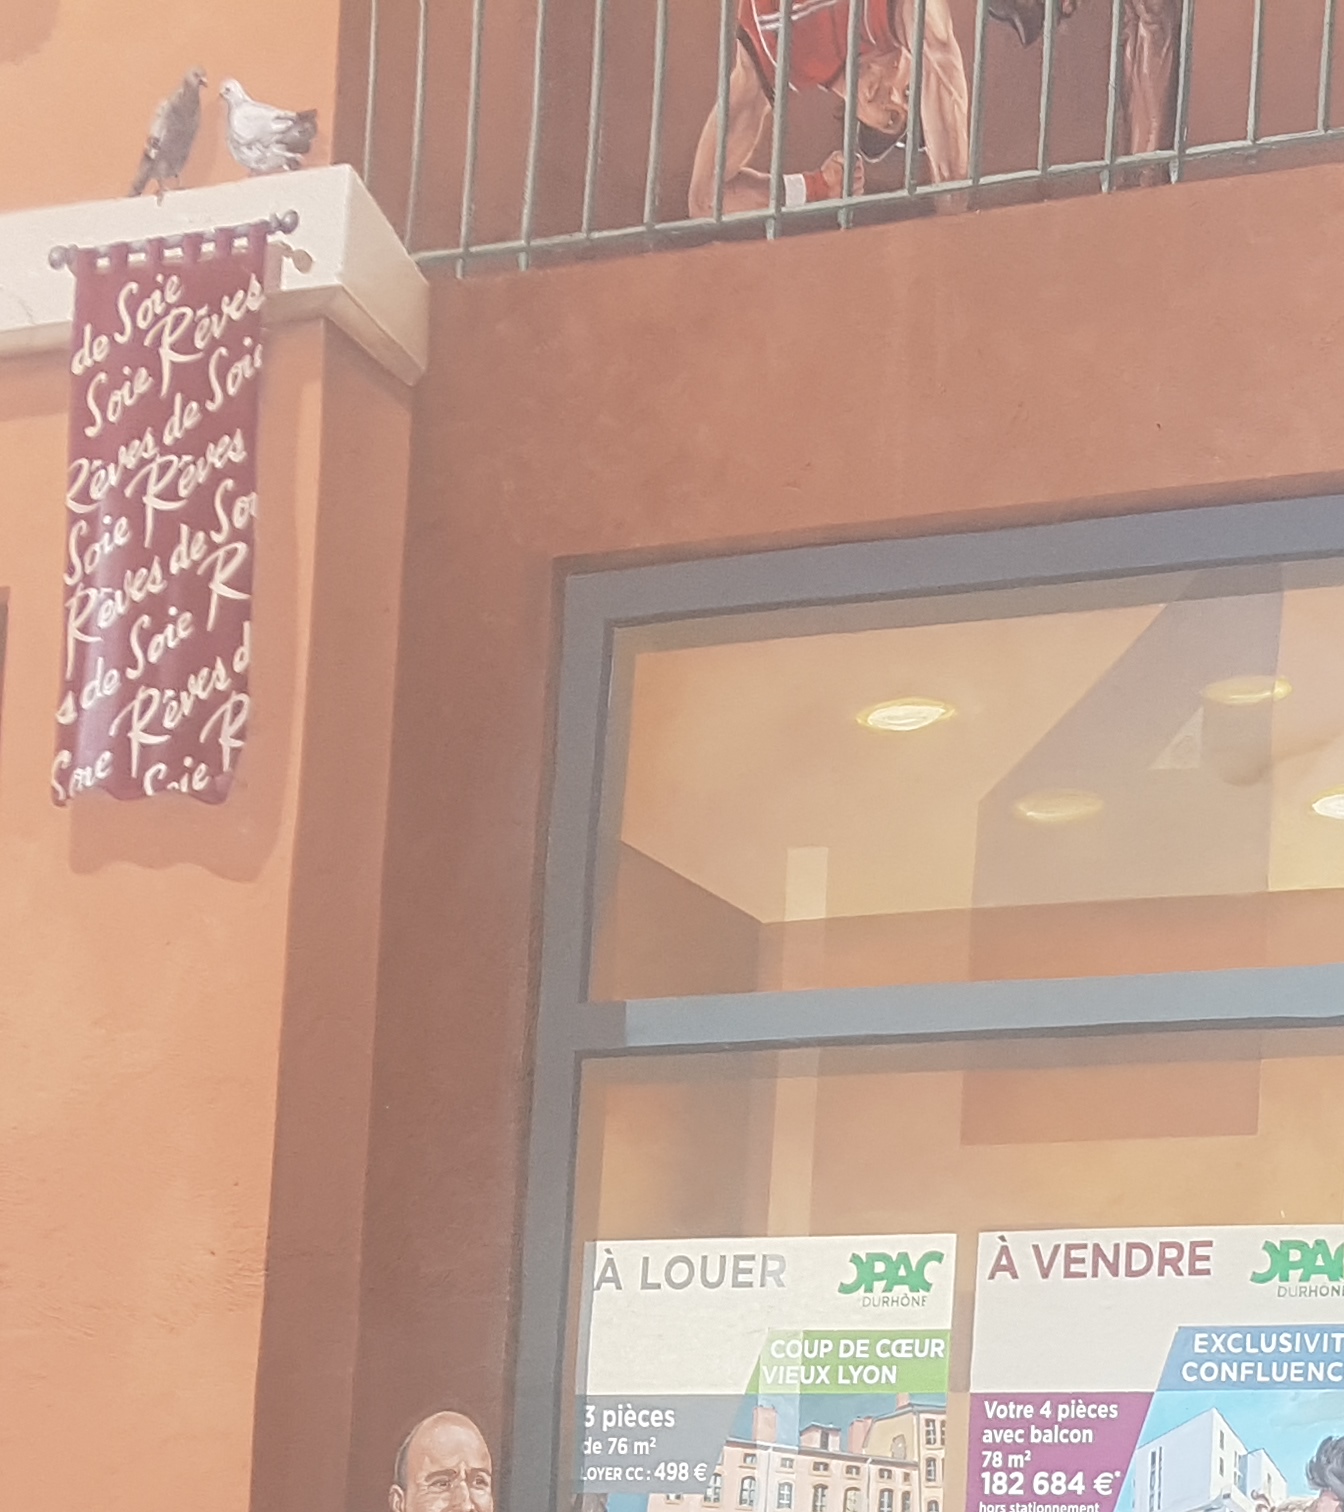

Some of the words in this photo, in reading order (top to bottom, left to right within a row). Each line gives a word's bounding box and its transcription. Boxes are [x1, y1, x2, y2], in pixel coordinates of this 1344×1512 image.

[114, 273, 185, 344] Soie
[84, 366, 153, 437] Soie
[63, 515, 132, 586] Soie
[125, 606, 195, 680] Soie
[593, 1247, 623, 1291] À
[639, 1253, 788, 1291] LOUER
[987, 1234, 1019, 1280] À
[1031, 1239, 1213, 1280] VENDRE
[769, 1338, 834, 1360] COUP
[838, 1339, 870, 1359] DE
[760, 1365, 832, 1385] VIEUX
[837, 1365, 898, 1385] LYON
[584, 1405, 596, 1428] 3
[601, 1404, 676, 1432] pièces
[983, 1400, 1034, 1420] Votre
[1039, 1400, 1052, 1420] 4
[1057, 1400, 1119, 1424] pièces
[583, 1438, 603, 1456] de
[607, 1437, 629, 1456] 76
[981, 1428, 1025, 1444] avec
[1030, 1425, 1093, 1445] balcon
[654, 1462, 689, 1481] 498
[981, 1451, 1003, 1468] 78
[980, 1473, 1024, 1496] 182
[1032, 1472, 1085, 1496] 684
